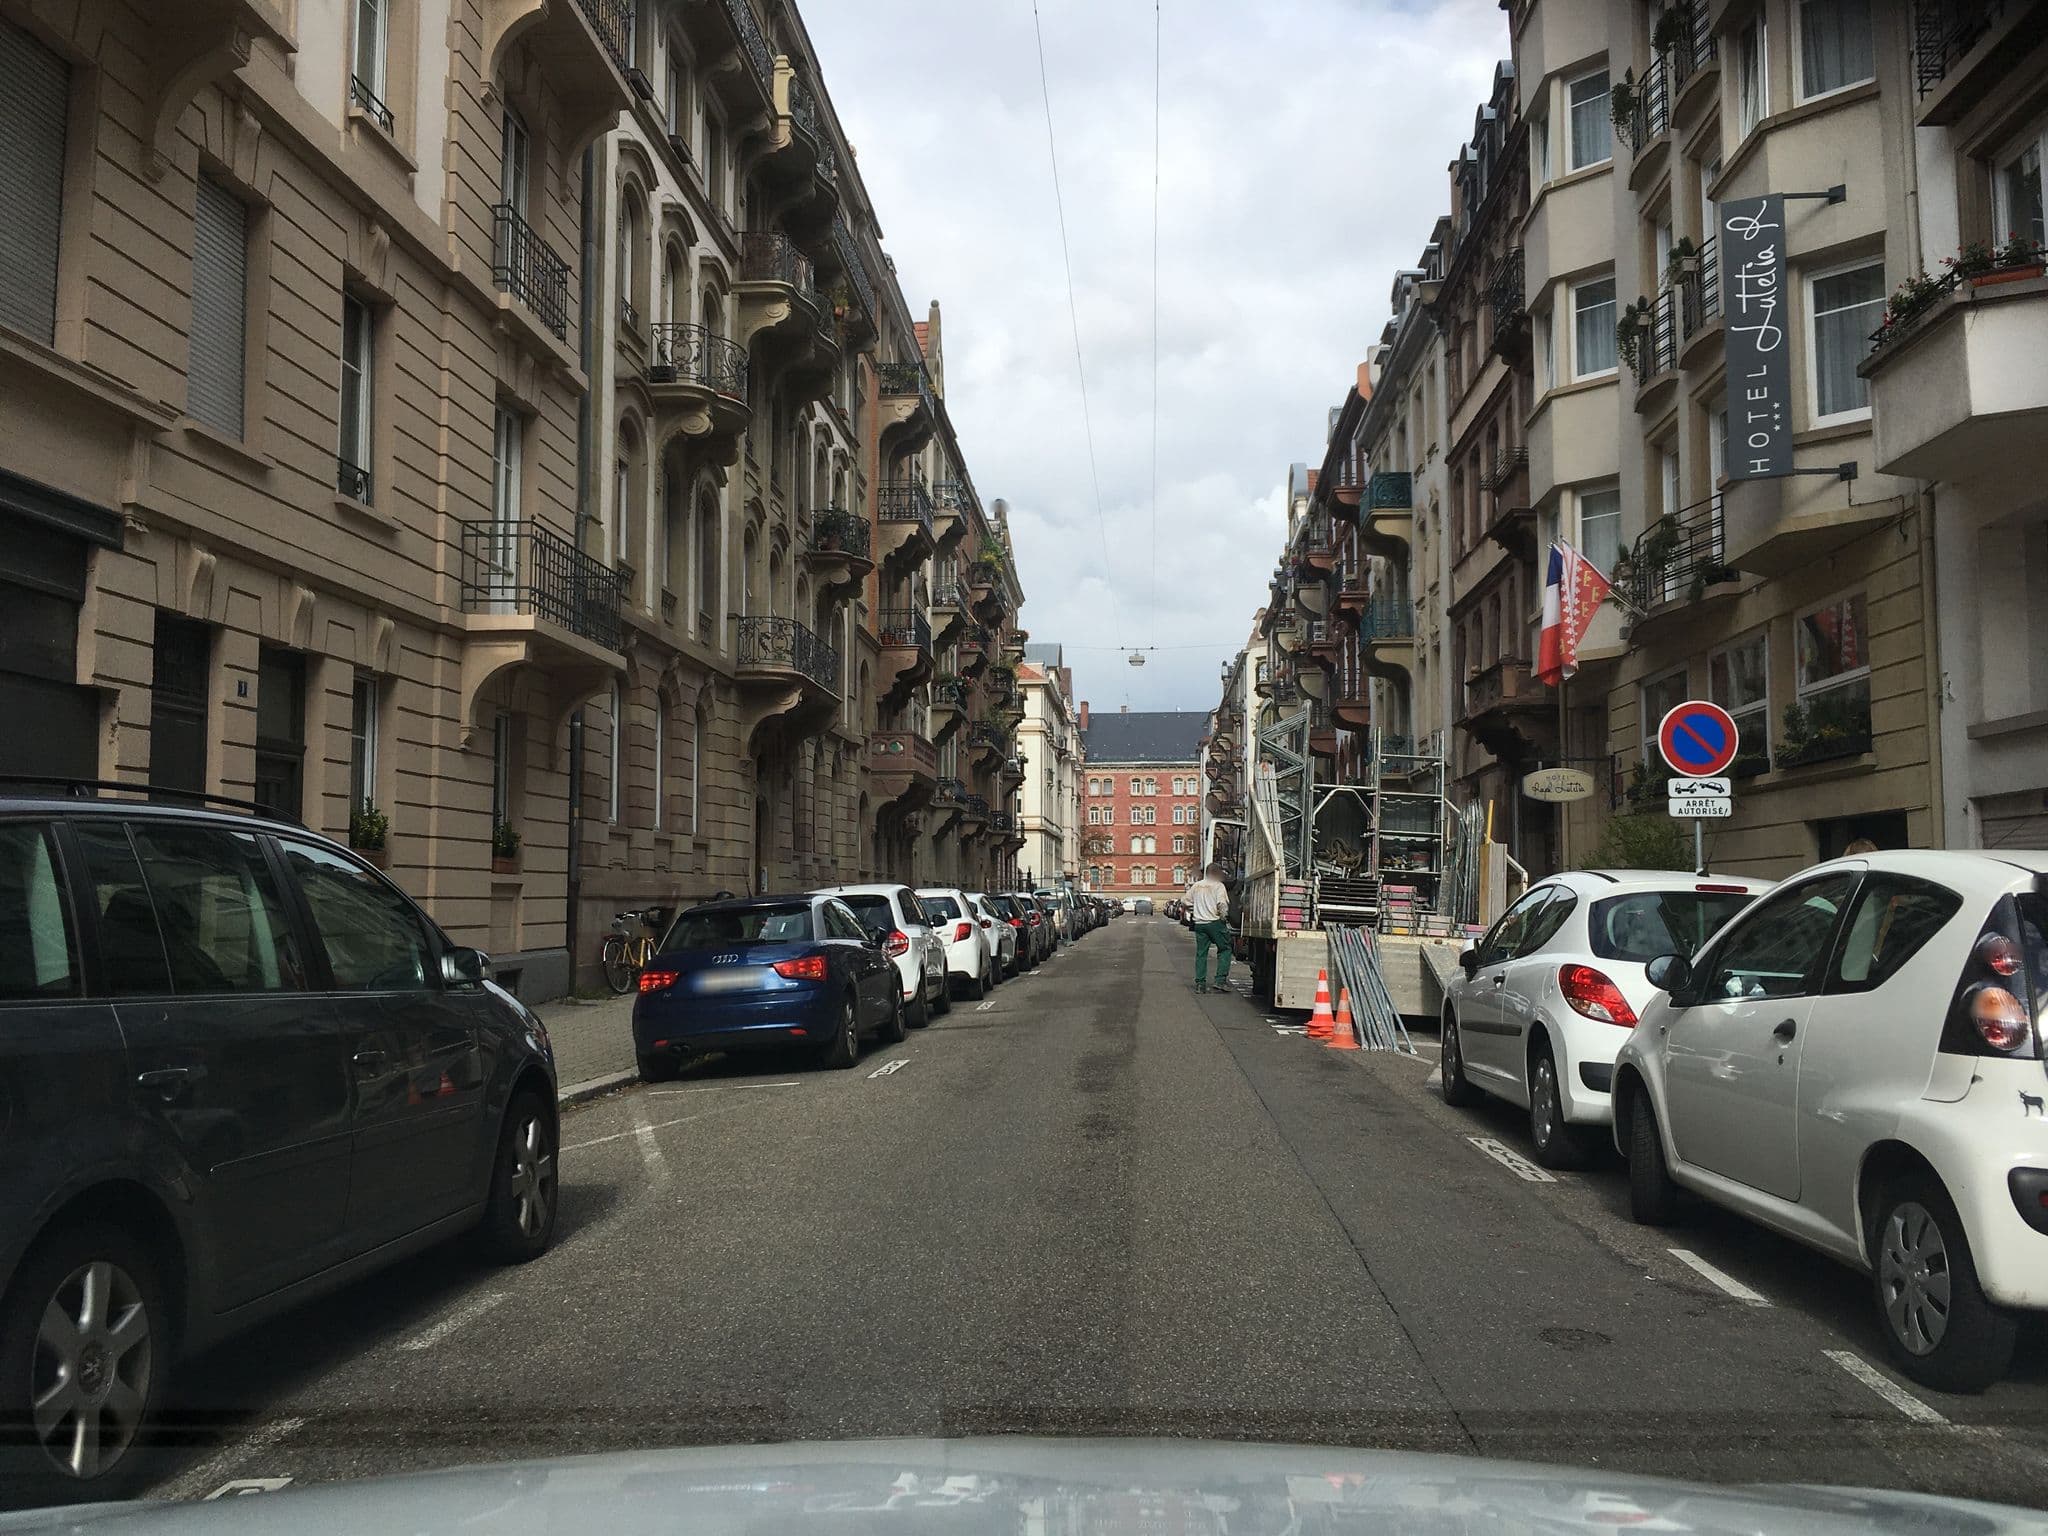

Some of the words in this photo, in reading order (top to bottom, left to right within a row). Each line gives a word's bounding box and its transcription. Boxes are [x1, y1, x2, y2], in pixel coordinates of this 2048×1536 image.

[1730, 243, 1782, 352] Lutetia
[1747, 364, 1770, 474] HOTEL
[1678, 806, 1723, 815] AUTORISÉ
[1686, 799, 1715, 807] ARRÊT
